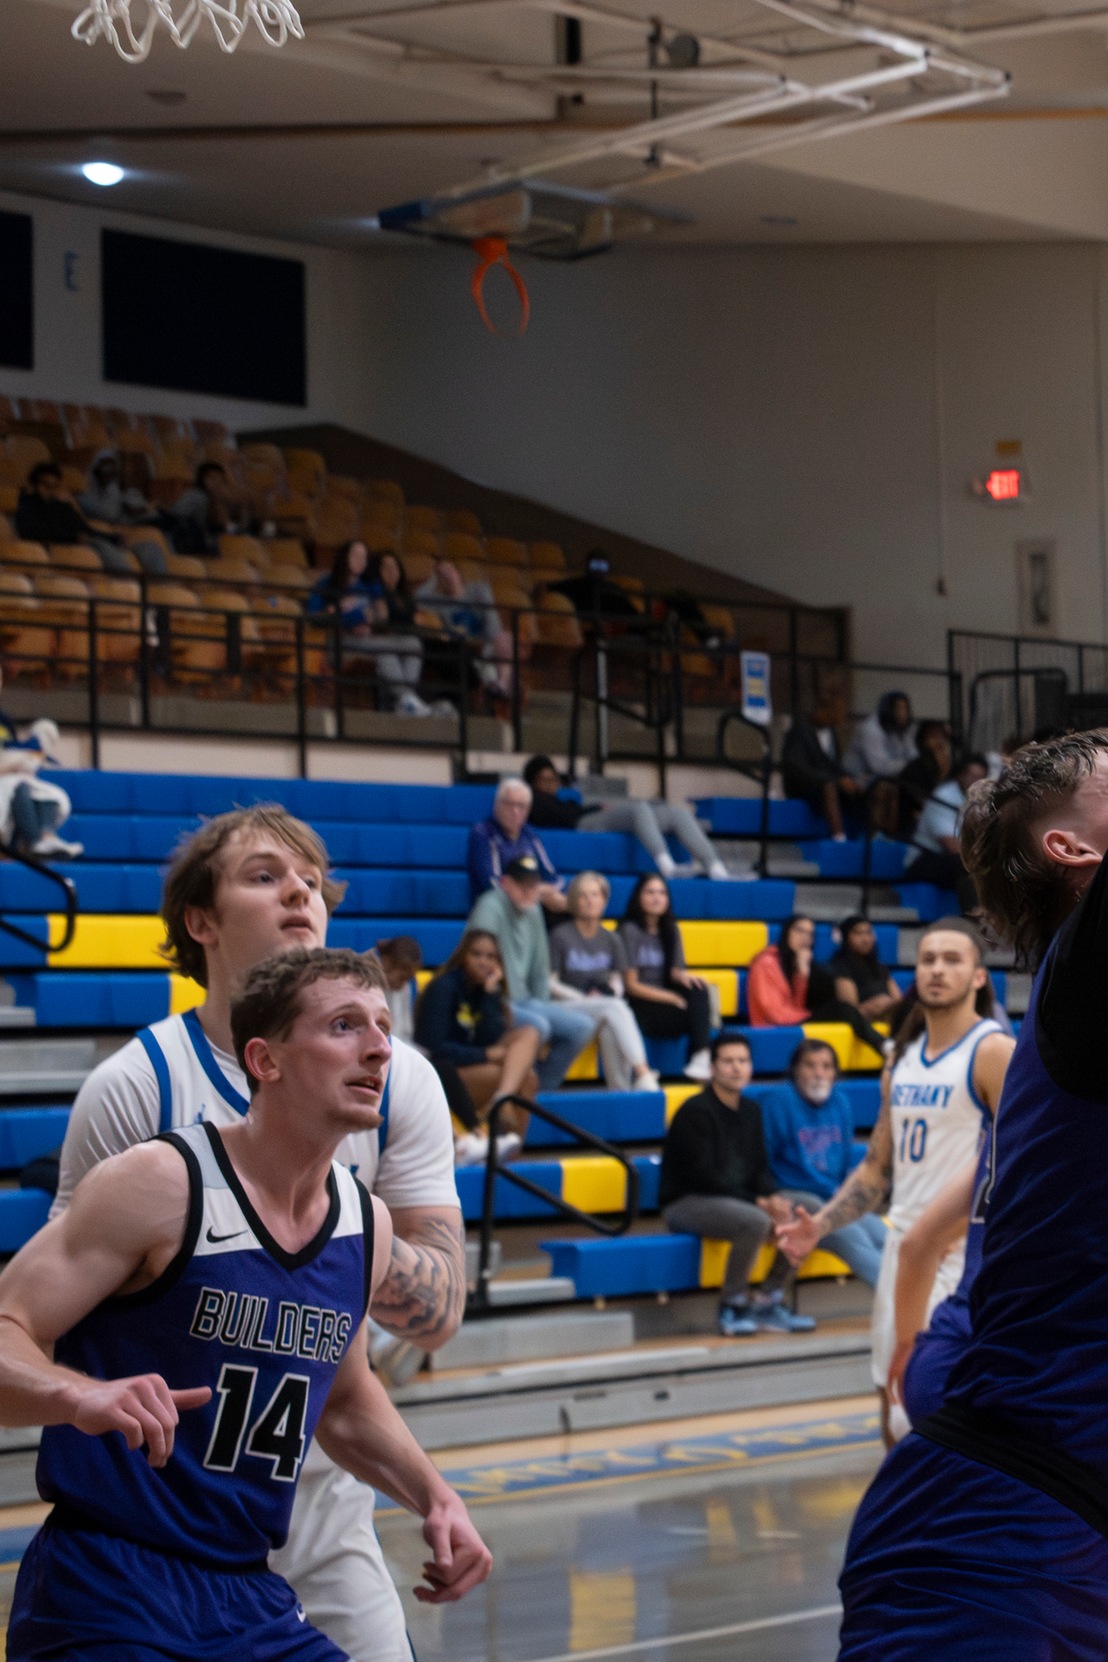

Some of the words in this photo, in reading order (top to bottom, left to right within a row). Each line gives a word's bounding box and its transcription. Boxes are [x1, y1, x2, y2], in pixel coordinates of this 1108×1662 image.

[900, 1117, 928, 1163] 10
[189, 1286, 352, 1364] BUILDERS
[202, 1362, 310, 1483] 14
